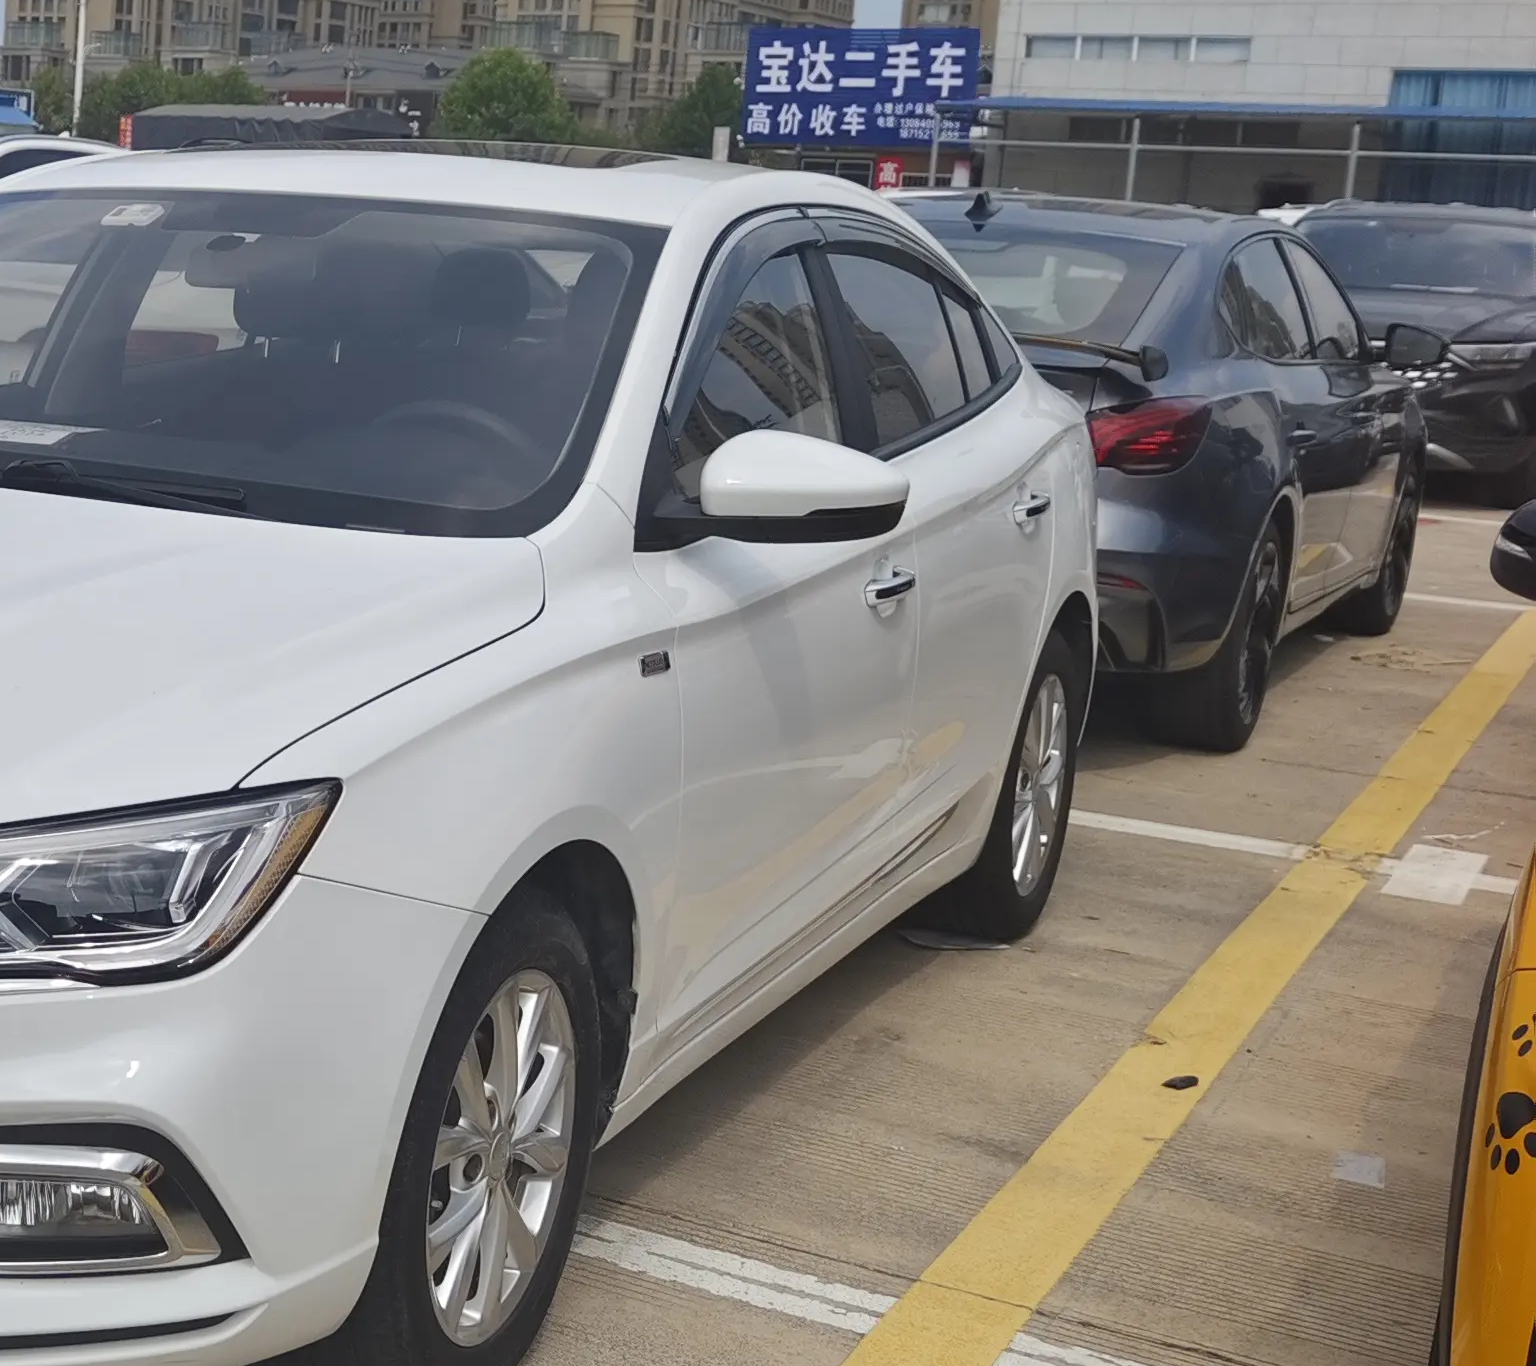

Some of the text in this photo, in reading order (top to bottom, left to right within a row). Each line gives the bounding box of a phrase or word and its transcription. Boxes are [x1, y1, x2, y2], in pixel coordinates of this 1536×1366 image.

[755, 40, 966, 97] 宝达二手车
[746, 101, 867, 136] 高价收车
[878, 161, 900, 191] 高
